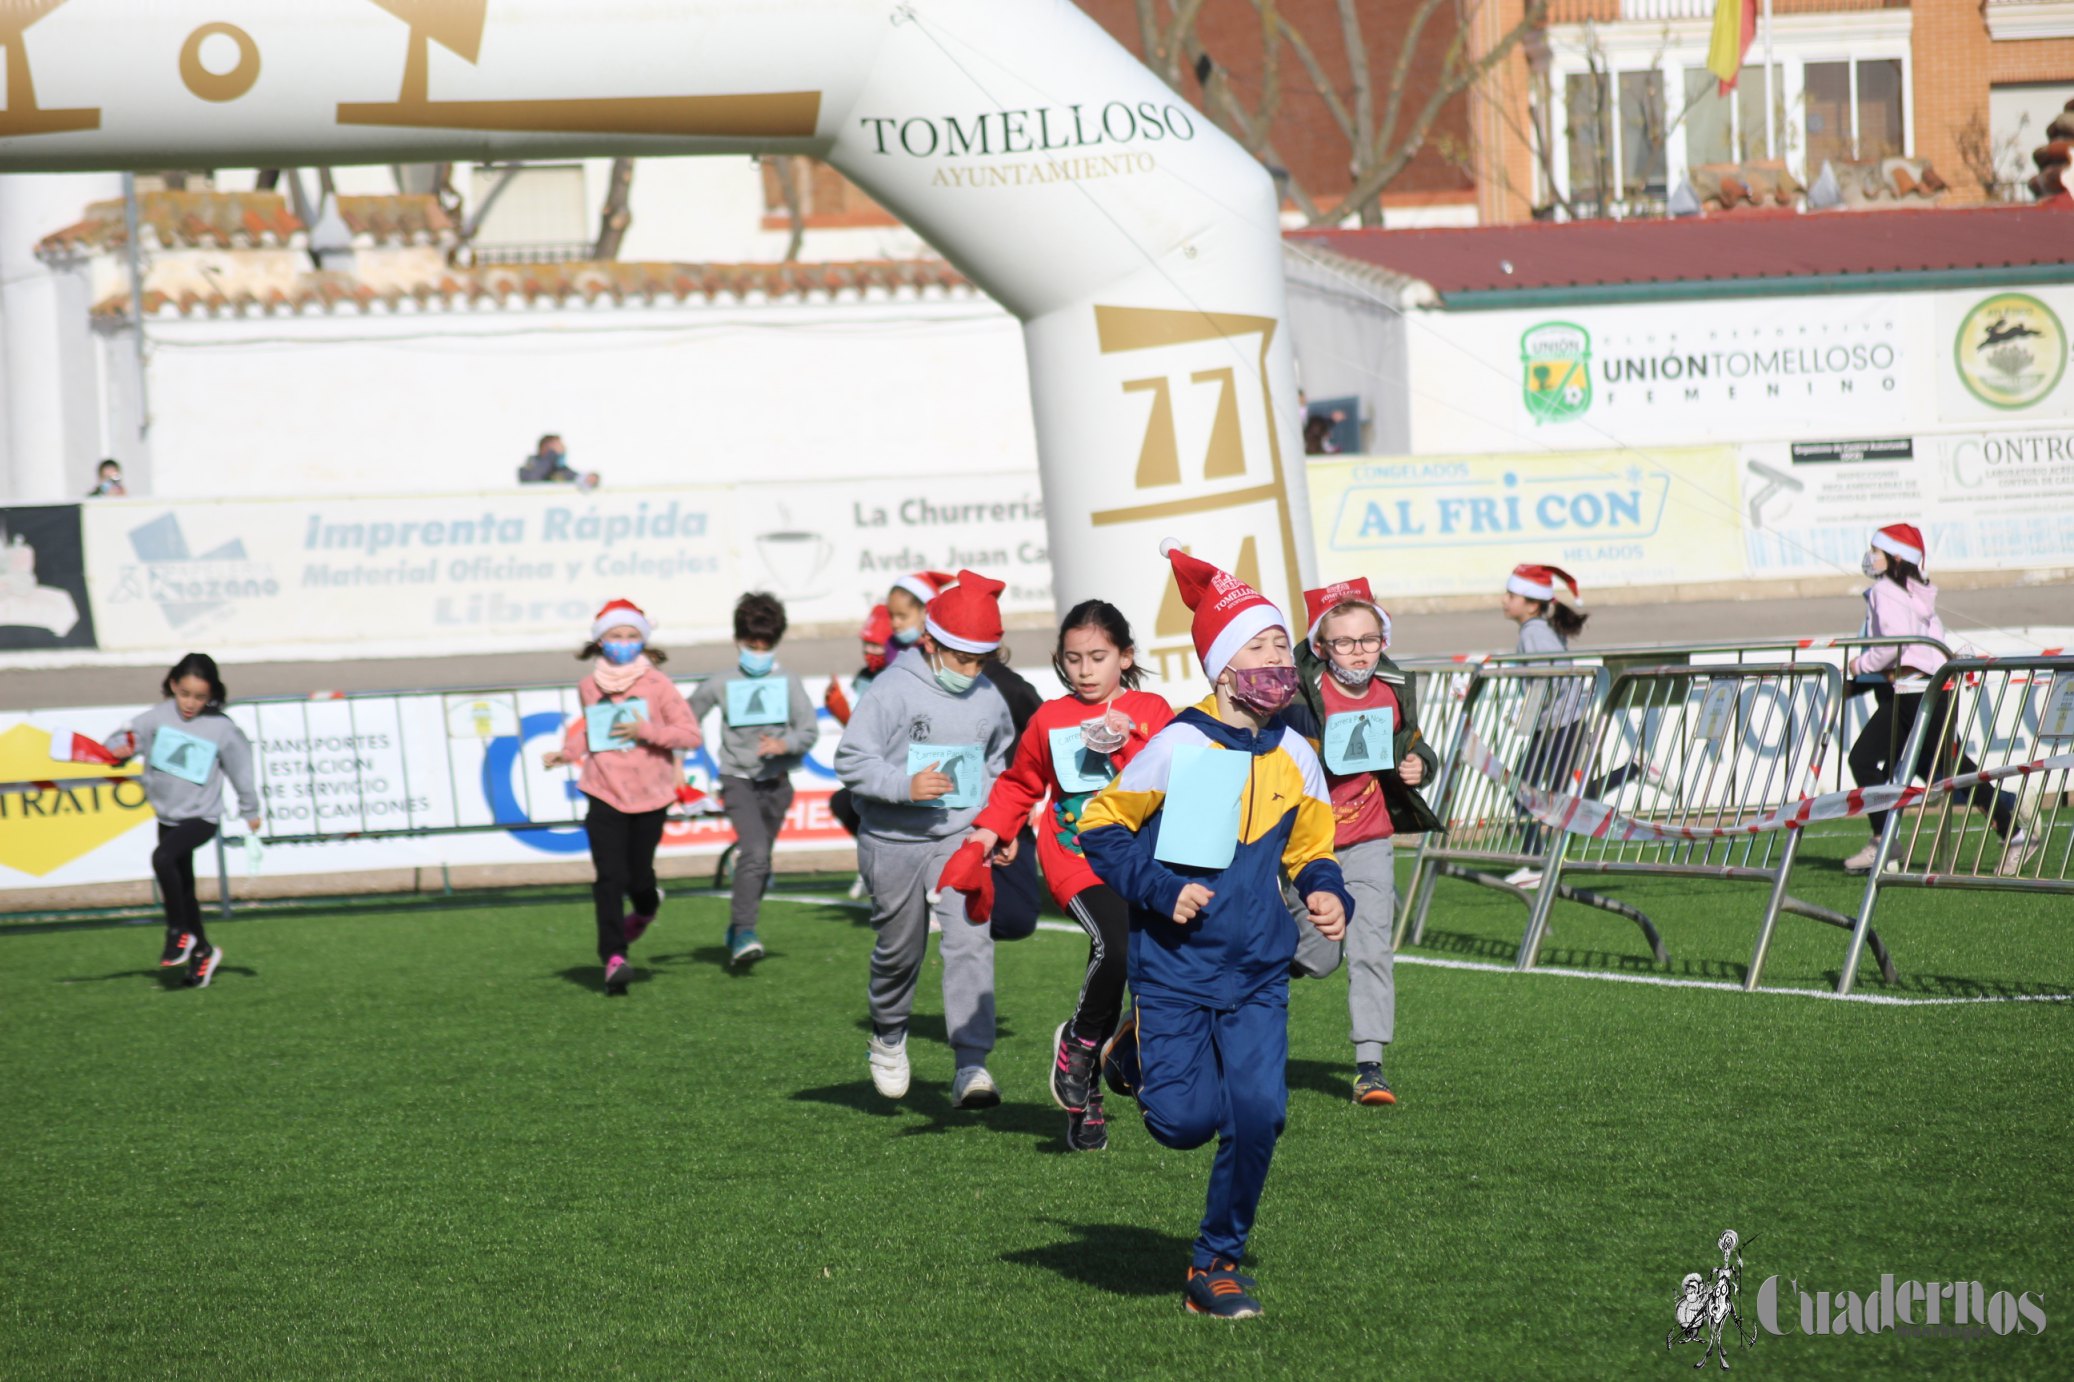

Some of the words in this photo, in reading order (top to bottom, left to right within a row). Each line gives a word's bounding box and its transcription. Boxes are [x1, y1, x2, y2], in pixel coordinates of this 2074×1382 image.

[860, 101, 1195, 158] TOMELLOSO
[932, 152, 1155, 188] AYUNTAMIENTO
[1608, 377, 1896, 405] FEMENINO
[854, 501, 888, 528] La
[899, 493, 1045, 526] Churrería
[1358, 499, 1425, 537] AL
[1536, 489, 1643, 530] CON
[303, 512, 526, 556] Imprenta
[540, 501, 709, 548] Rápida
[945, 545, 1008, 569] Juan
[1017, 541, 1049, 564] Ca
[1563, 544, 1644, 562] HELADOS
[301, 558, 437, 588] Material
[449, 553, 555, 583] Oficina
[565, 559, 583, 584] y
[434, 592, 600, 625] Libro
[248, 734, 391, 755] TRANSPORTES
[269, 756, 374, 776] ESTACION
[293, 776, 390, 799] SERVICIO
[316, 797, 431, 820] CAMIONES
